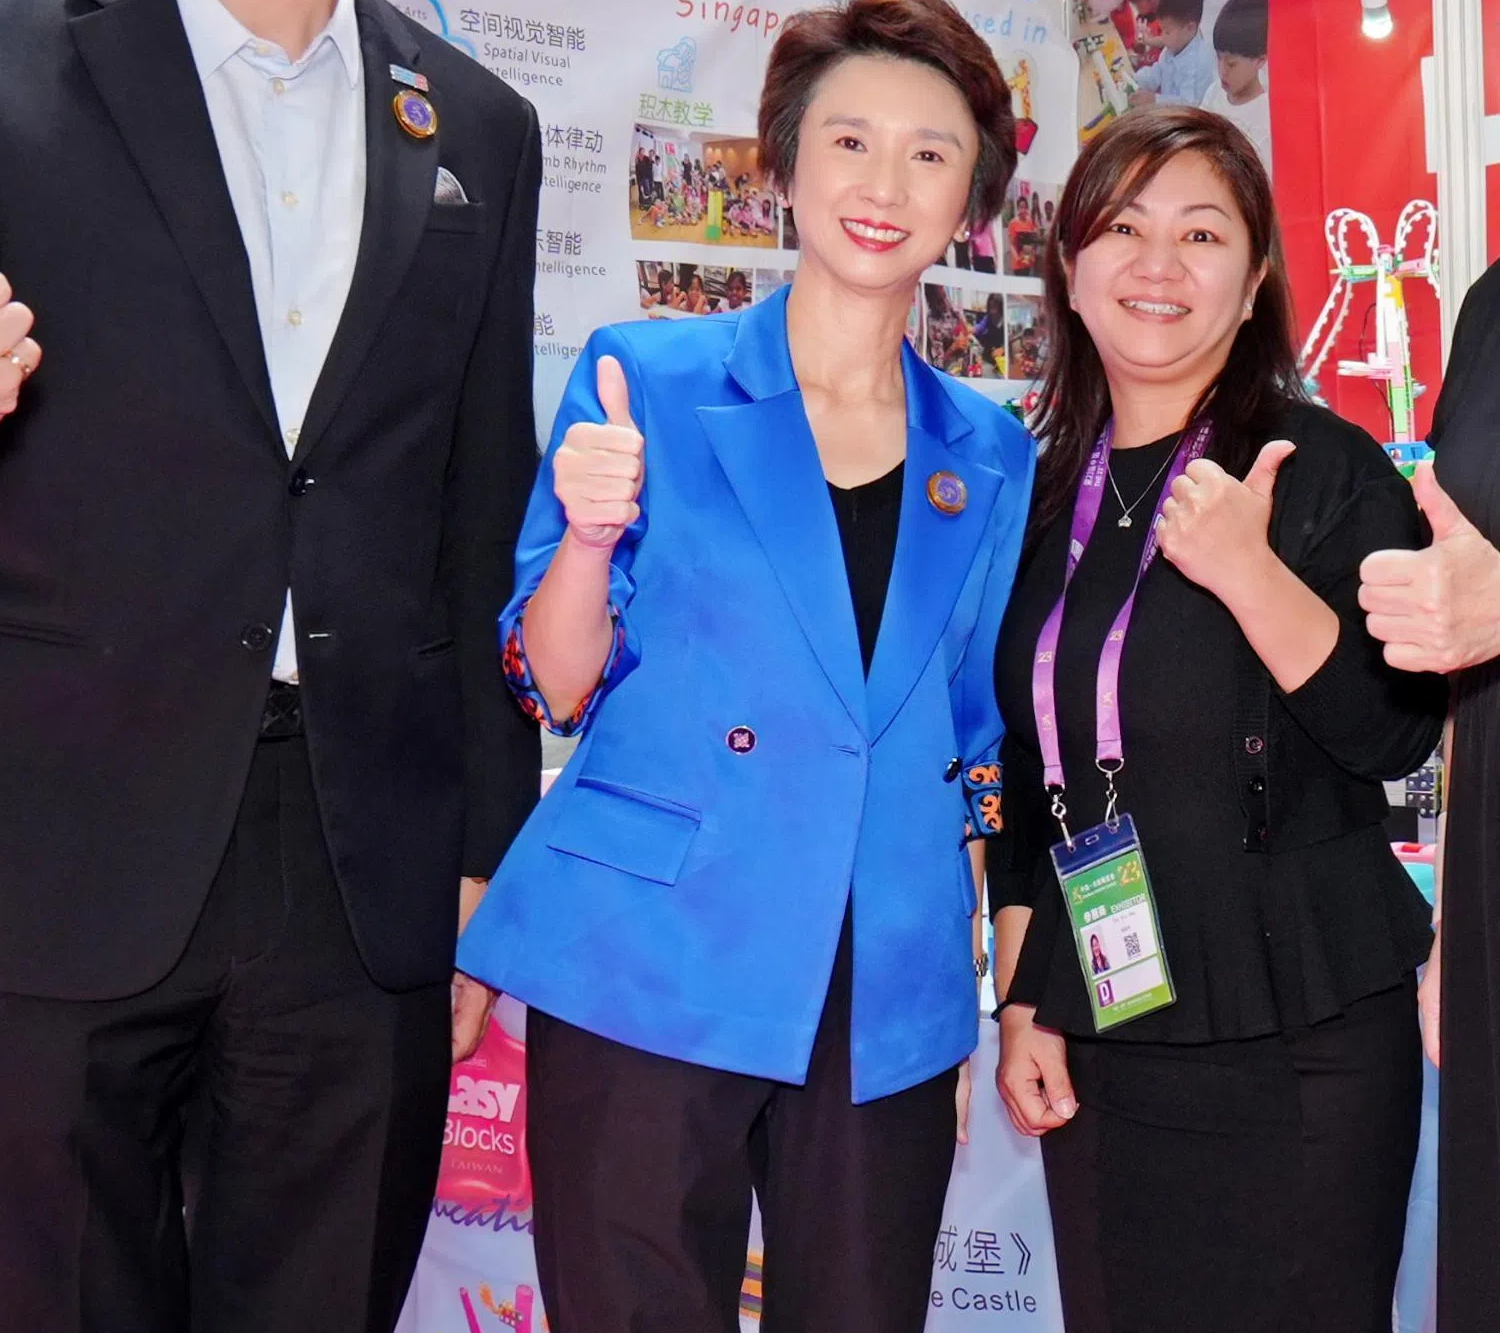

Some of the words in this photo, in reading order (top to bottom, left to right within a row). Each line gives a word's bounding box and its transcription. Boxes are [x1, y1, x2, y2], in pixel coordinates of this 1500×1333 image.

[459, 8, 587, 52] 空间视觉智能
[1022, 14, 1049, 44] in
[484, 42, 528, 63] Spatial
[531, 48, 572, 69] Visual
[637, 92, 714, 128] 积木教学
[540, 124, 604, 154] 体律动
[564, 155, 608, 175] Rhythm
[543, 174, 602, 194] telligence
[951, 1287, 1037, 1313] Castle
